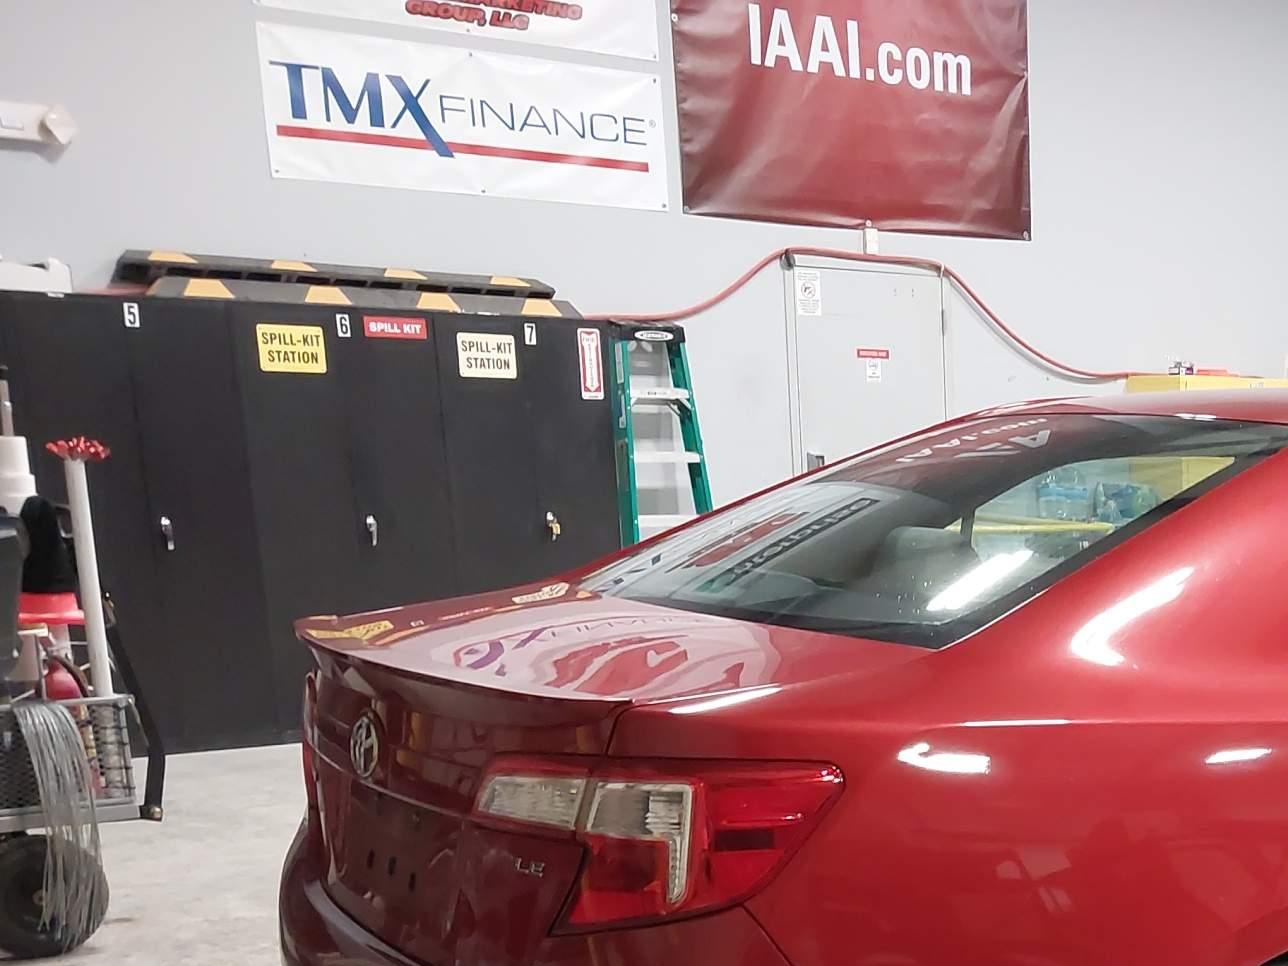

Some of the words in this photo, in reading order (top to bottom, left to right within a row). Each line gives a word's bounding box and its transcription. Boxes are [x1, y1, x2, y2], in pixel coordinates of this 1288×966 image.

[405, 0, 487, 27] GROUP,
[489, 10, 530, 31] LLC
[748, 3, 972, 96] IAAI.com
[269, 60, 455, 159] TMX
[127, 305, 137, 325] 5
[339, 316, 349, 335] 6
[368, 321, 401, 334] SPILL
[402, 323, 422, 335] KIT
[525, 324, 534, 344] 7
[261, 331, 321, 348] SPILL-KIT
[461, 339, 513, 355] SPILL-KIT
[267, 350, 319, 365] STATION
[466, 356, 511, 371] STATION
[514, 857, 545, 878] LE
